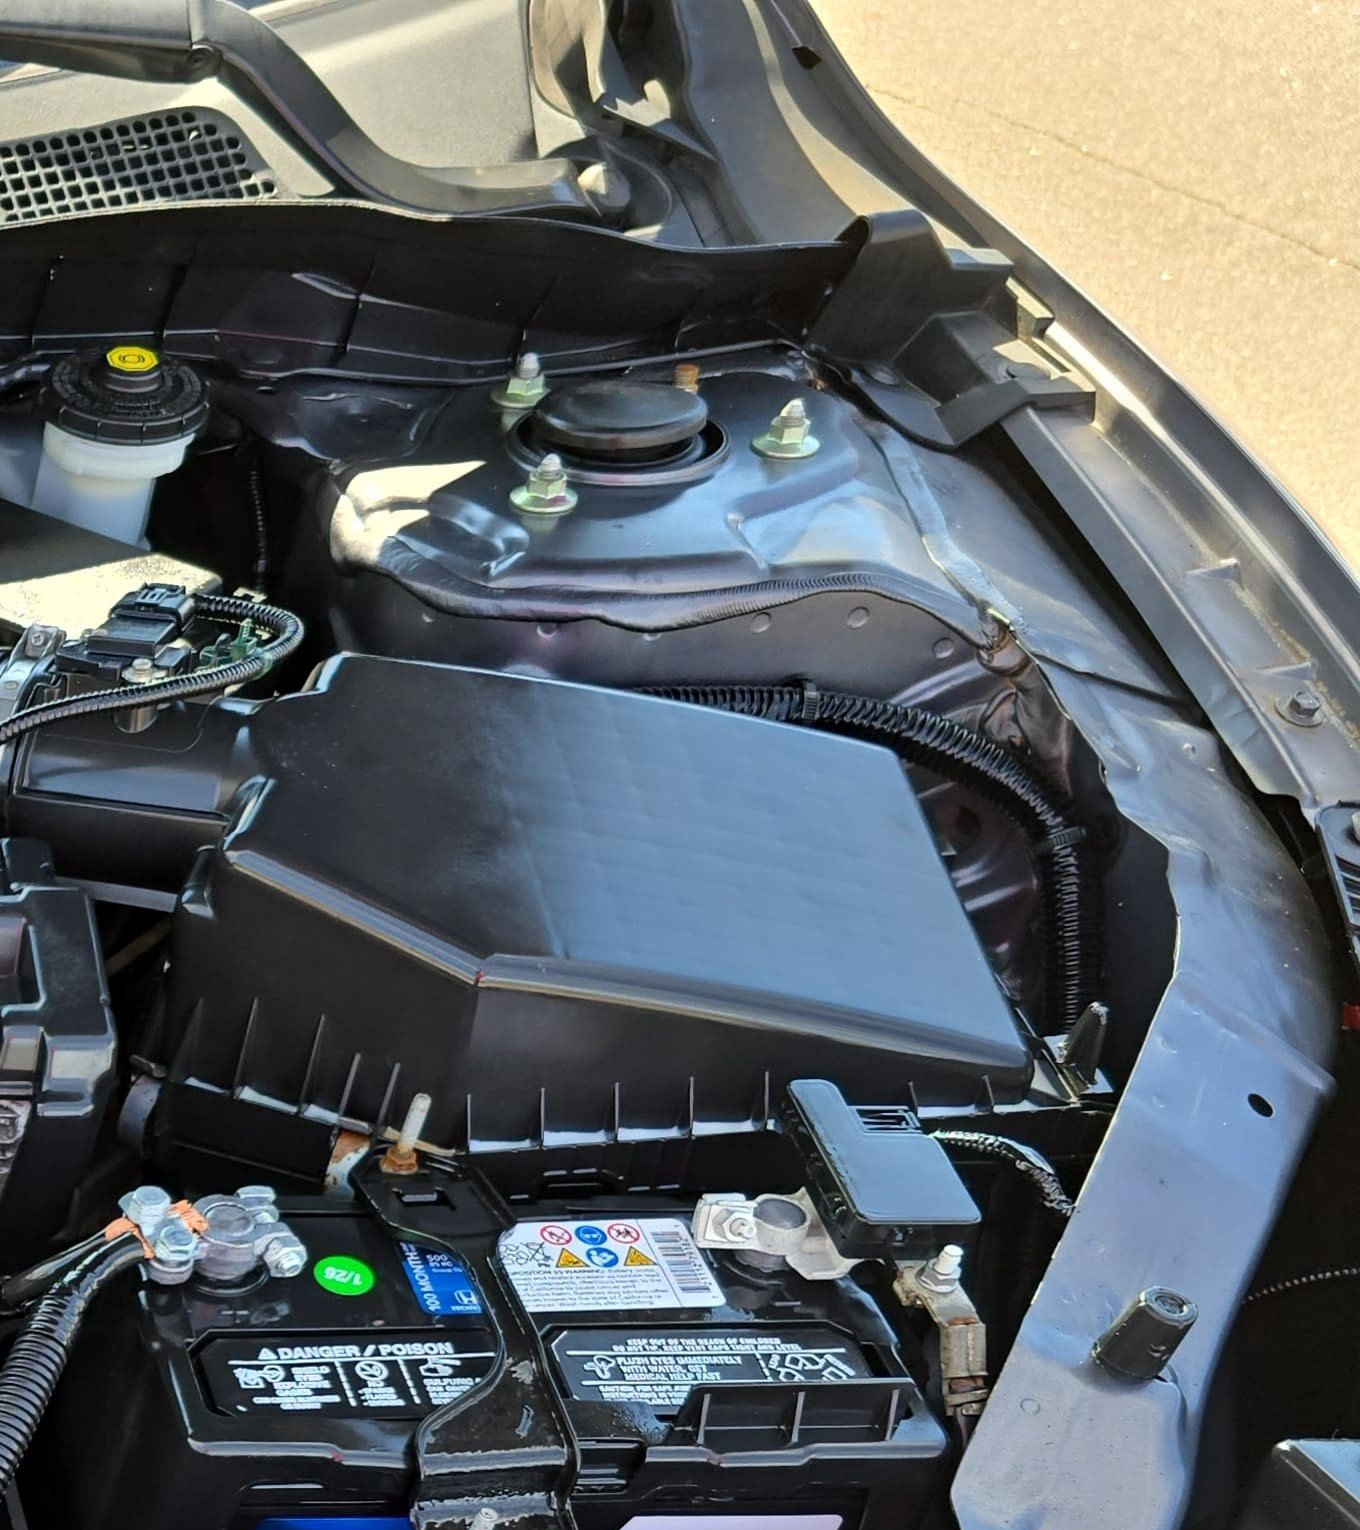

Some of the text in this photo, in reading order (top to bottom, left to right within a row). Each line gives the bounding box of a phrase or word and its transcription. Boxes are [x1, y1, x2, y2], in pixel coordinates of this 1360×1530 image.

[324, 1266, 364, 1286] 1/26
[277, 1345, 361, 1360] DANGER
[378, 1342, 455, 1356] POISON
